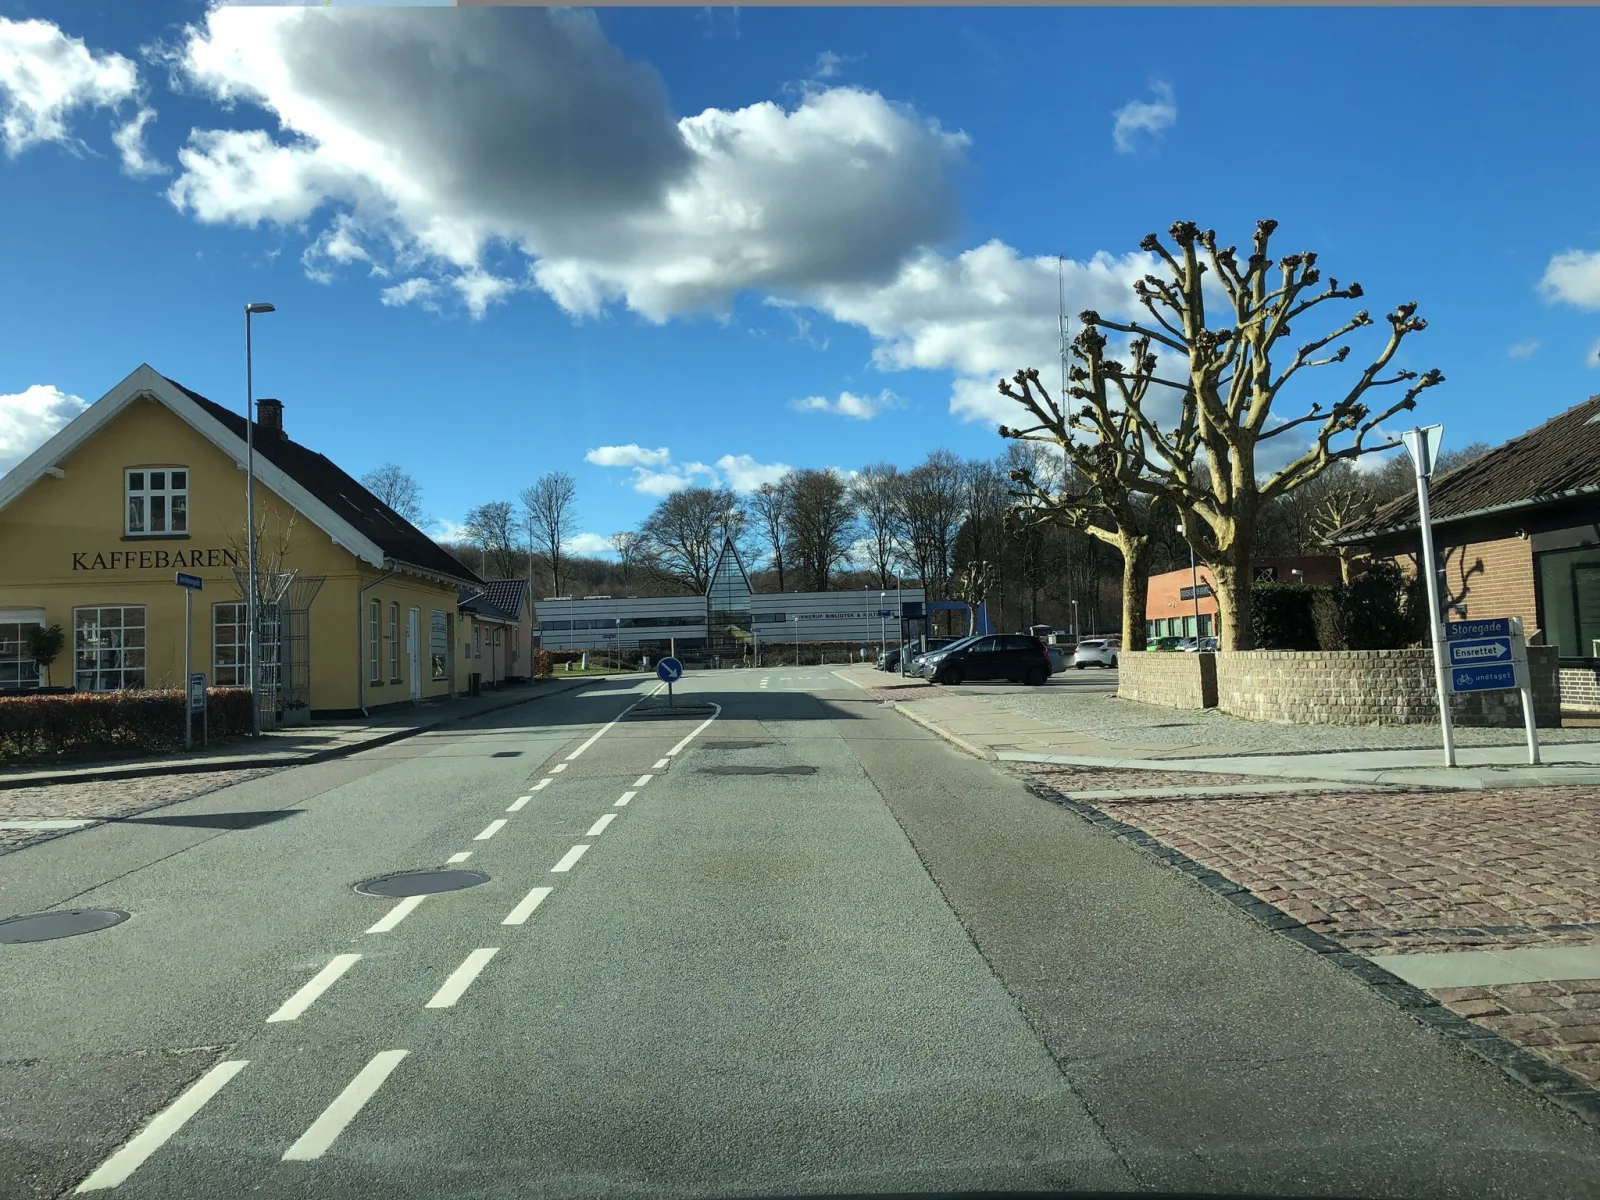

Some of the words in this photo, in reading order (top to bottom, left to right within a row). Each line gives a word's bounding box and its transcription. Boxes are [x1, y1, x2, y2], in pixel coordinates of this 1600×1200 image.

[72, 549, 238, 571] KAFFEBAREN
[1452, 621, 1502, 635] Storegade
[1455, 646, 1497, 657] Ensrettet
[1475, 672, 1511, 681] undtaget
